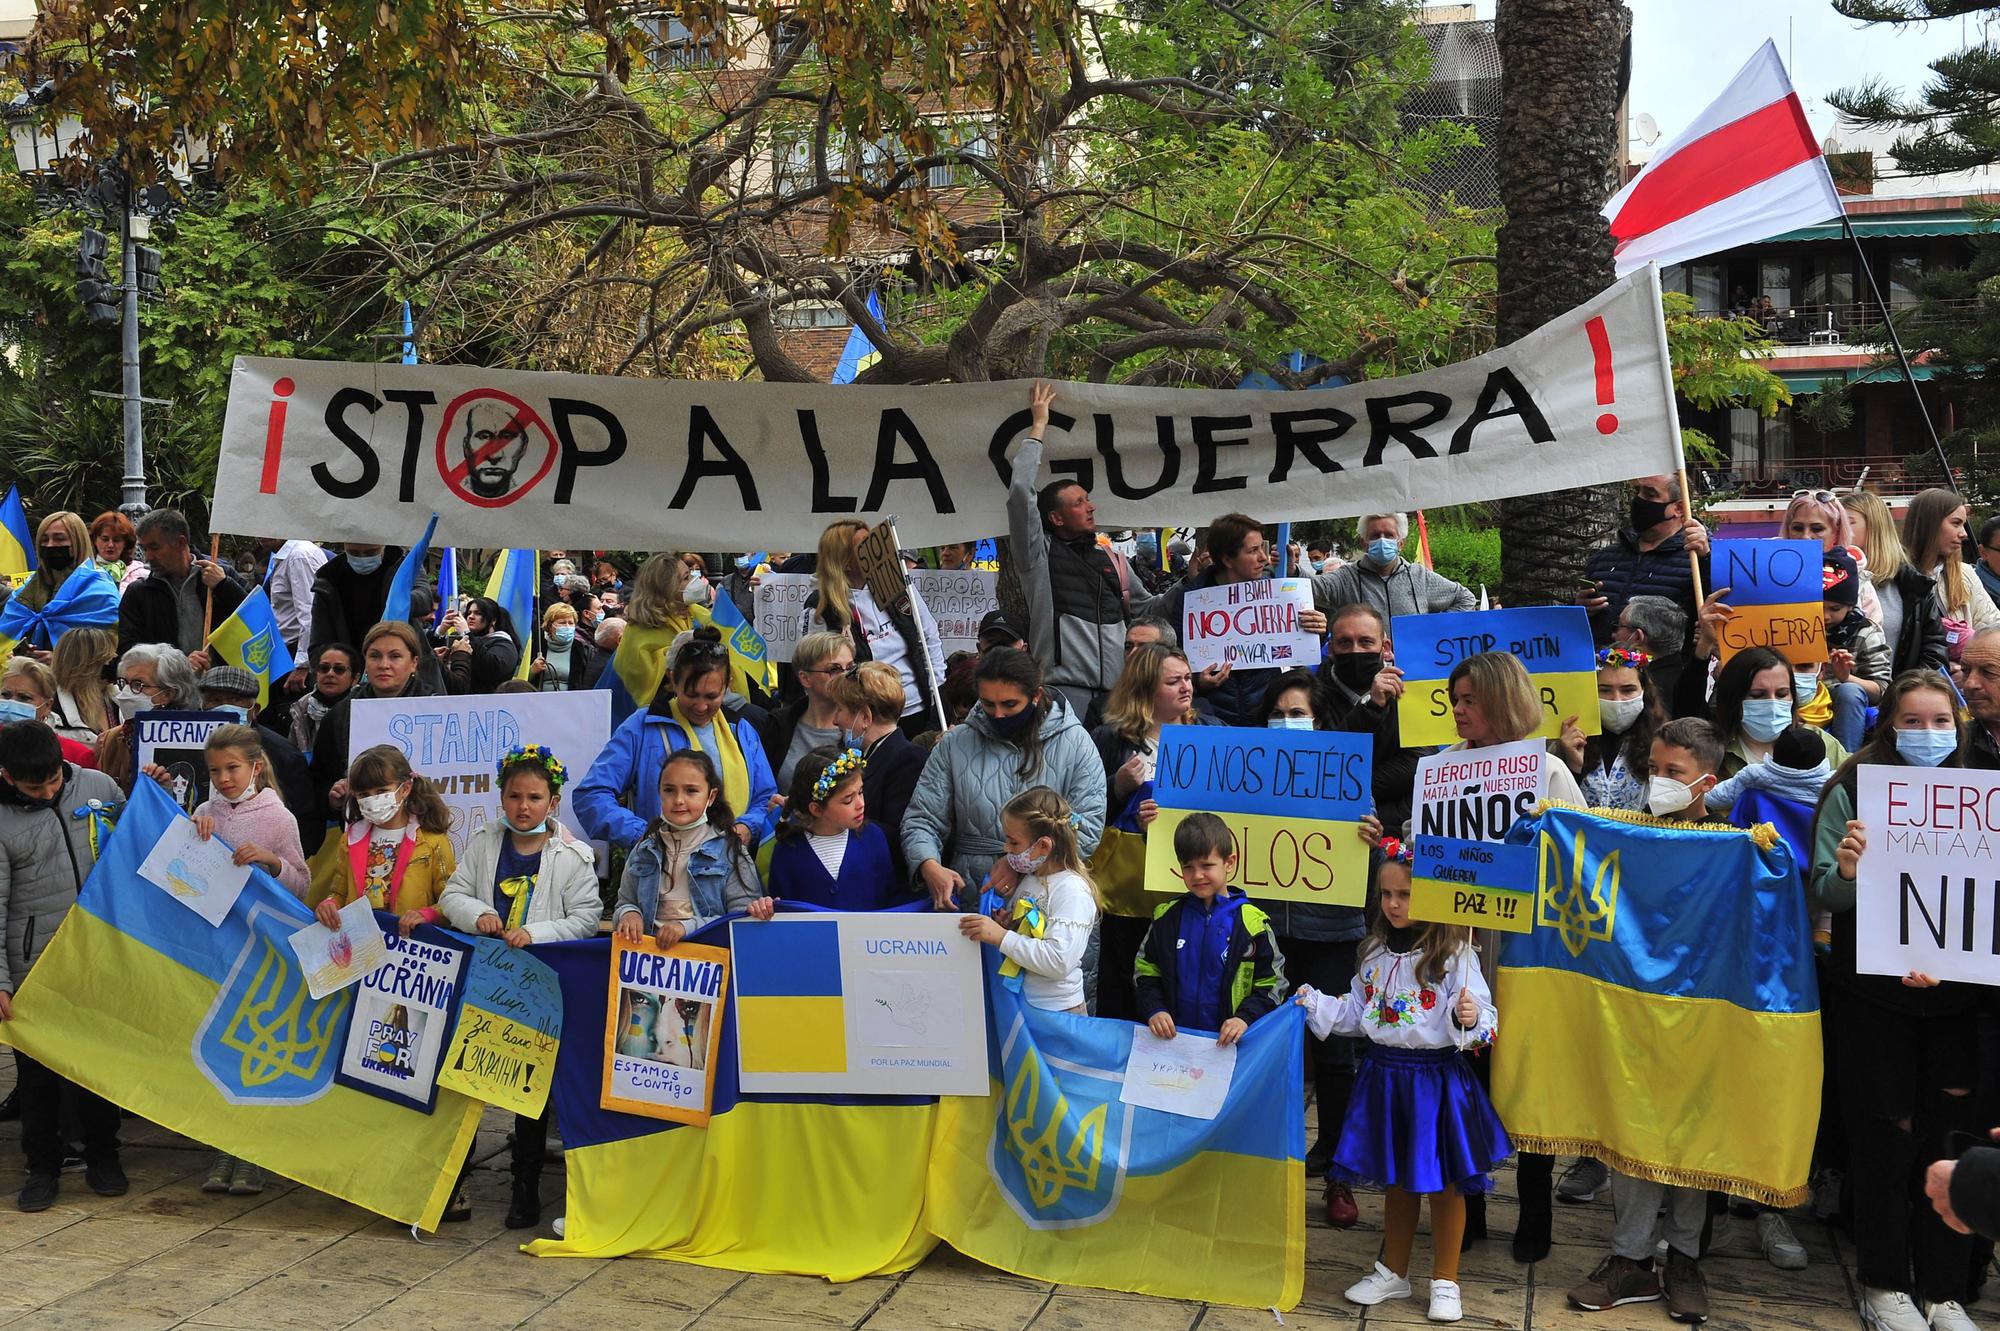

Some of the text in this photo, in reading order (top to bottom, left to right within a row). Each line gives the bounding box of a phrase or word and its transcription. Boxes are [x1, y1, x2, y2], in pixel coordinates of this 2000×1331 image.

[667, 405, 762, 511] A
[797, 407, 956, 513] LA
[858, 523, 889, 573] STOP
[866, 558, 906, 603] PUTIN
[1729, 547, 1803, 588] NO
[762, 584, 808, 603] STOP
[763, 614, 801, 642] STO
[1188, 603, 1299, 640] NO GUERRA
[1723, 615, 1826, 649] GUERRA
[1224, 643, 1271, 663] NO WAR
[1435, 634, 1497, 666] STOP
[140, 721, 225, 743] UCRAN
[389, 710, 520, 765] STAND
[1158, 743, 1363, 801] NO NOS DEJÉIS
[1424, 754, 1538, 785] EJÉRCITO RUSO
[427, 774, 490, 794] WITH
[1423, 776, 1537, 800] MATA A NUESTROS
[1421, 845, 1444, 859] LOS
[1887, 830, 1992, 859] MATA A
[1170, 827, 1334, 891] LOS
[1454, 891, 1487, 914] PAZ
[384, 932, 452, 964] OREMOS
[866, 940, 948, 955] UCRANIA
[402, 957, 427, 972] POR
[369, 1020, 417, 1047] PRAY
[365, 1038, 413, 1069] FOR
[871, 1058, 952, 1068] POR LA PAZ MUNDIAL
[361, 1057, 408, 1080] UKRAINE
[614, 1059, 679, 1081] ESTAMOS
